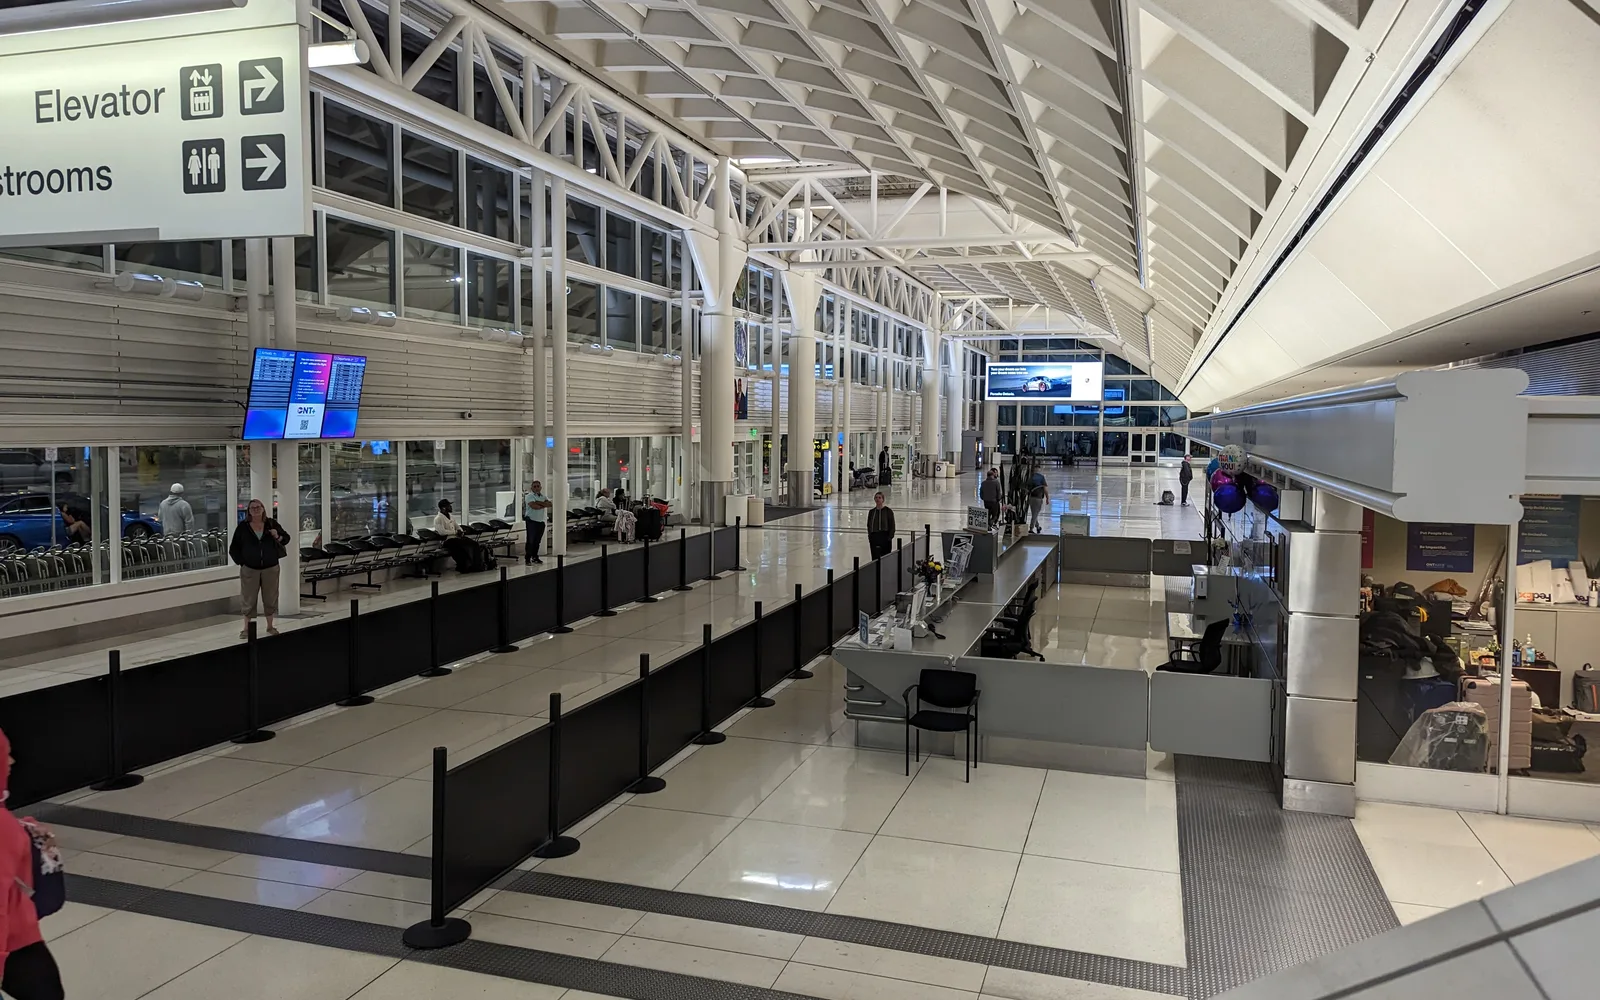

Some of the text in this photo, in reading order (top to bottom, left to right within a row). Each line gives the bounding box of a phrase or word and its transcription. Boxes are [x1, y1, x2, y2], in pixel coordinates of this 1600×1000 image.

[35, 84, 165, 123] Elevator
[0, 164, 113, 196] trooms
[968, 507, 987, 519] Baggage
[1519, 592, 1551, 602] FedEx
